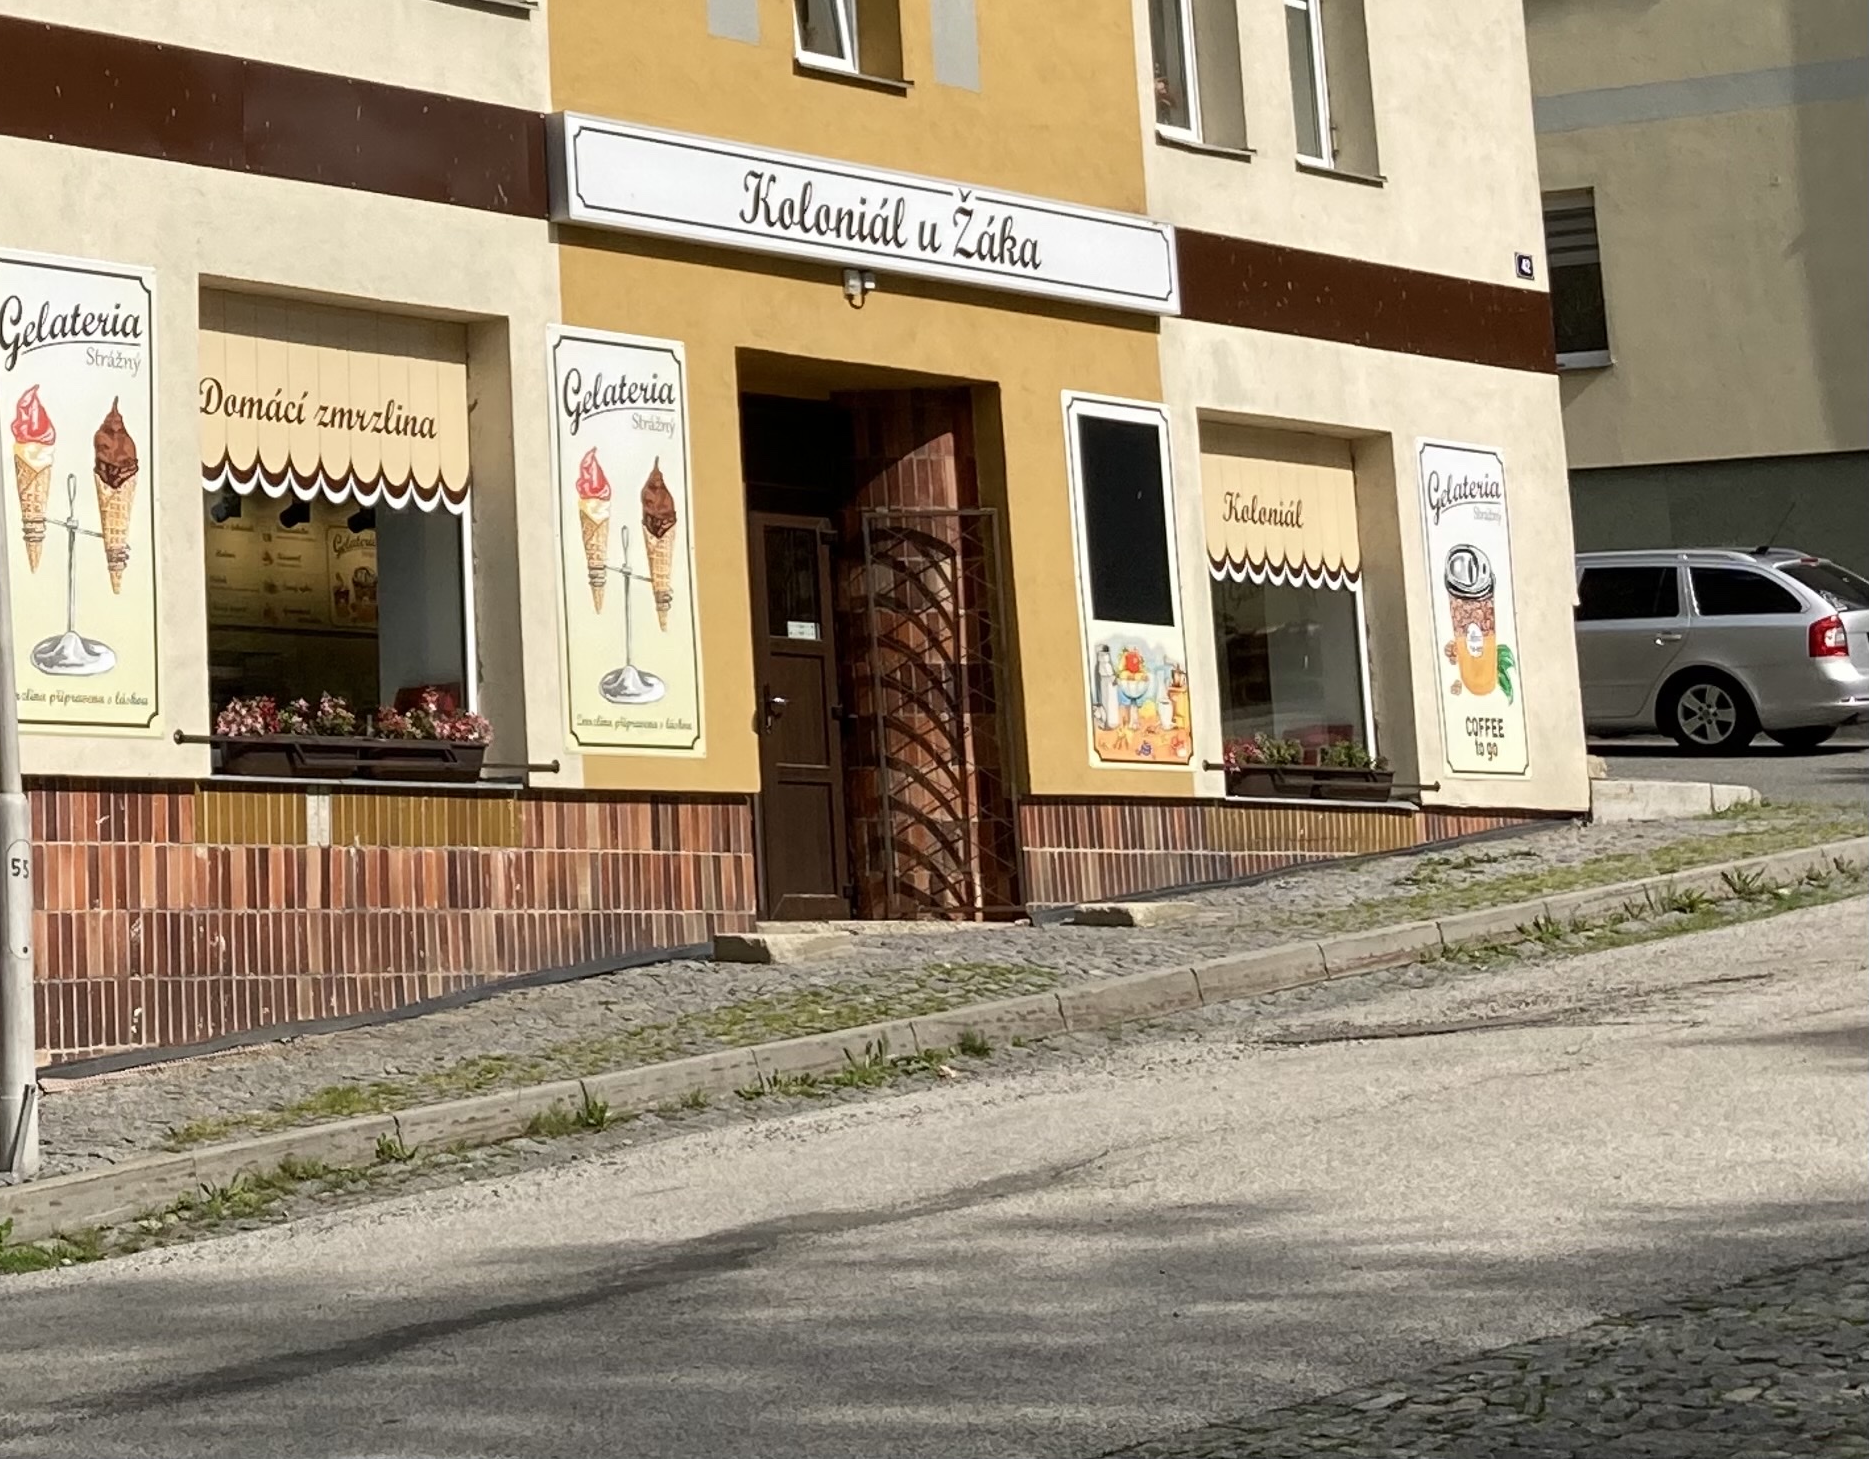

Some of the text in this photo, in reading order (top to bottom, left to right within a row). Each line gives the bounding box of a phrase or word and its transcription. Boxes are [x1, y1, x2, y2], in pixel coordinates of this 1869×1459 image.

[739, 169, 1042, 270] Koloniál u Žáka
[85, 346, 141, 378] Strážný
[199, 377, 437, 439] Domácí zmrzlina
[563, 367, 676, 436] Gelateria
[632, 412, 676, 439] Strážný
[1222, 491, 1305, 529] Koloniál
[1428, 470, 1501, 526] Gelateria
[1465, 715, 1505, 738] COFFEE
[1475, 737, 1498, 762] to go
